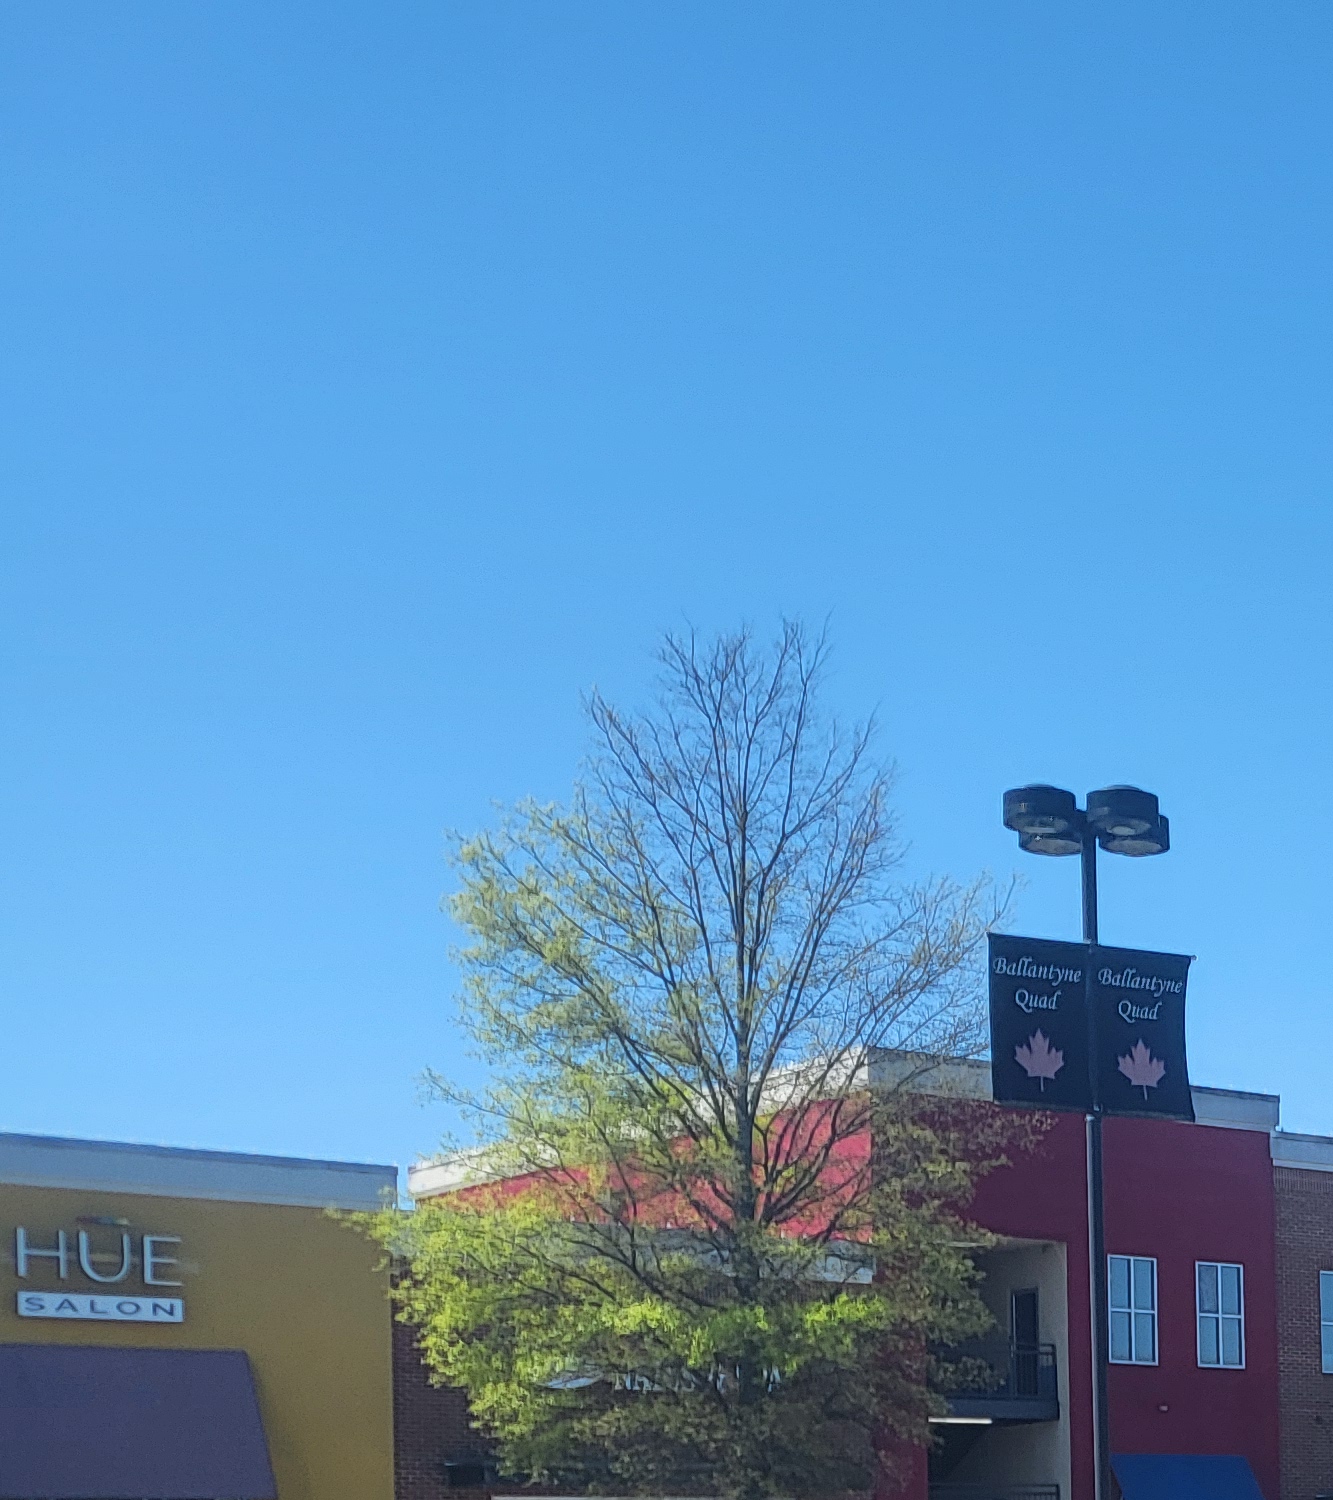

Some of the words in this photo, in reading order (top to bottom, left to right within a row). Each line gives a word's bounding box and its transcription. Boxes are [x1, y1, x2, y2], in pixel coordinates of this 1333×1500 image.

[993, 957, 1082, 986] Ballantyne
[1098, 968, 1184, 997] Ballantyne
[1015, 989, 1061, 1013] Quad
[1118, 1000, 1162, 1023] Quad
[16, 1227, 183, 1286] HUE
[24, 1298, 175, 1317] SALON
